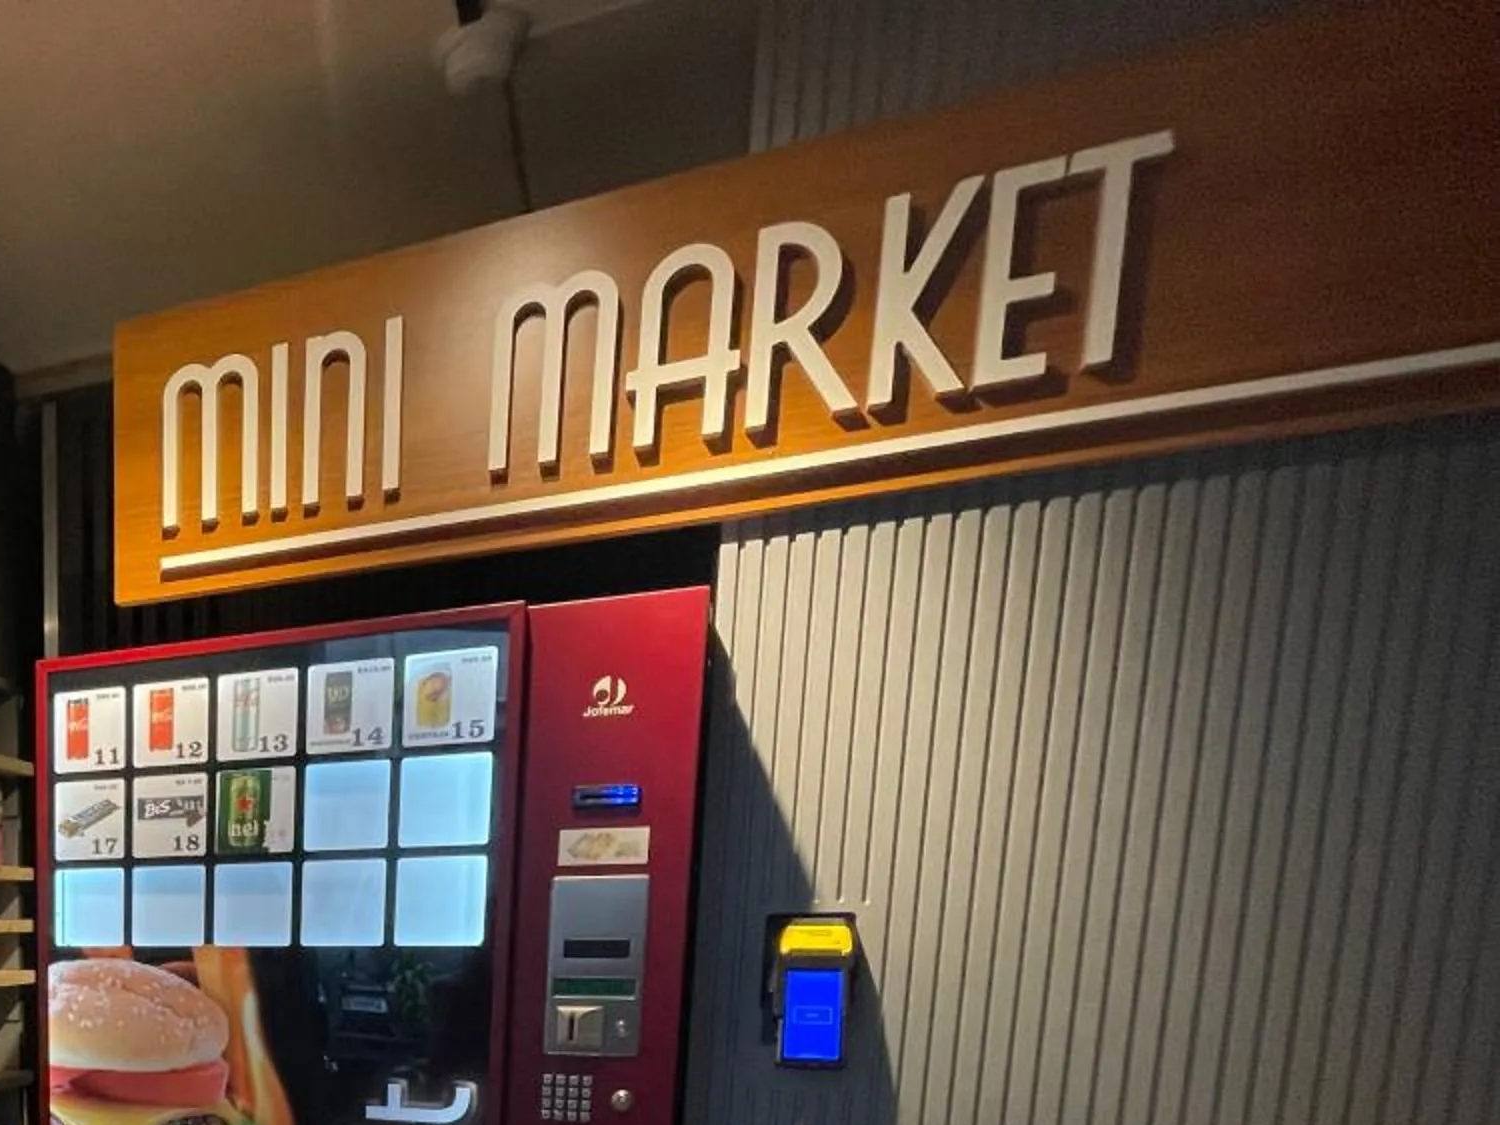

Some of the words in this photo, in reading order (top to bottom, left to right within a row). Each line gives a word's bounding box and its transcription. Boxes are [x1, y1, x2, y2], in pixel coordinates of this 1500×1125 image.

[487, 130, 1178, 485] MARKET
[352, 726, 385, 747] 14
[451, 719, 485, 739] 15
[175, 741, 203, 759] 12
[259, 733, 290, 753] 13
[92, 837, 118, 855] 17
[173, 834, 200, 851] 18
